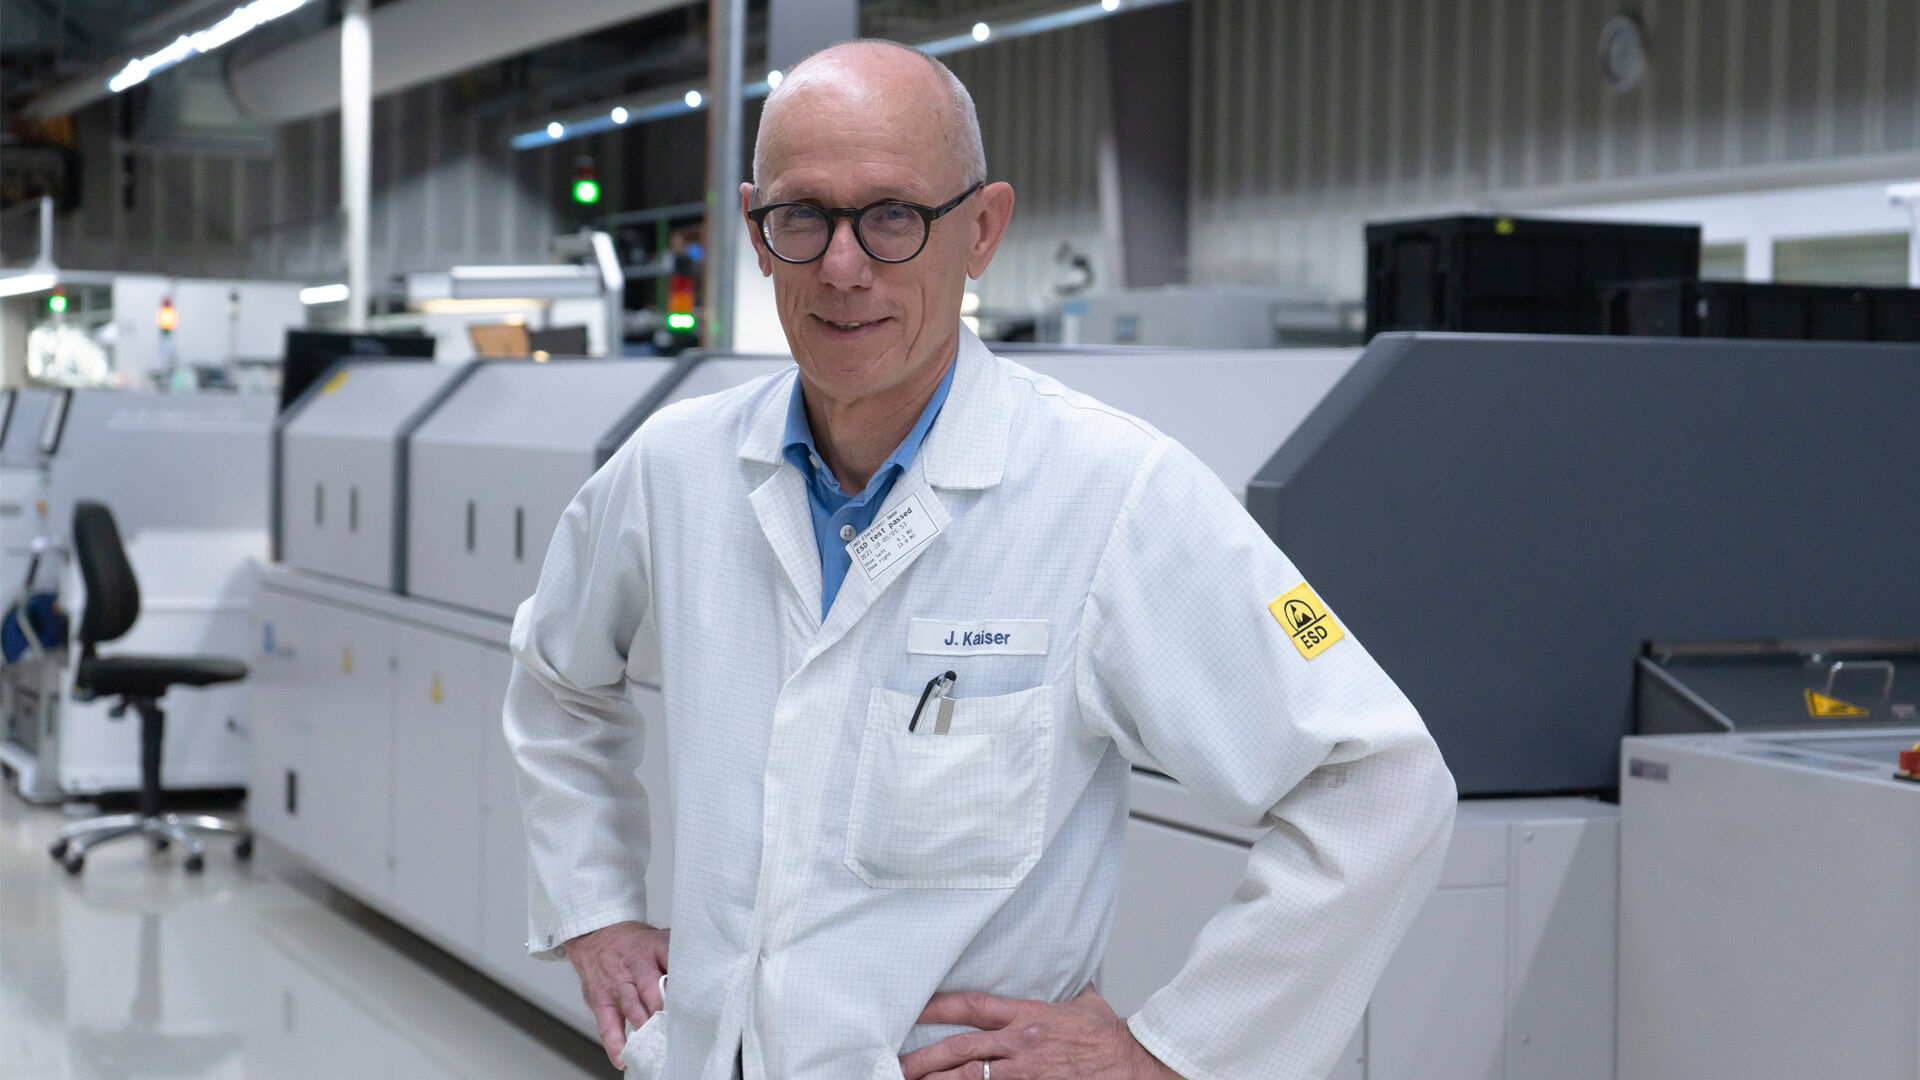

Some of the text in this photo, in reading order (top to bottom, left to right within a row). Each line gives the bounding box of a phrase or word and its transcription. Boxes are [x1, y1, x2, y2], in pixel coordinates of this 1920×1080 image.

[855, 506, 913, 554] ESD test passed
[866, 562, 878, 572] Shoe
[879, 552, 892, 563] right
[875, 548, 887, 558] left
[944, 630, 1011, 646] J. Kaiser
[1300, 625, 1328, 650] ESD
